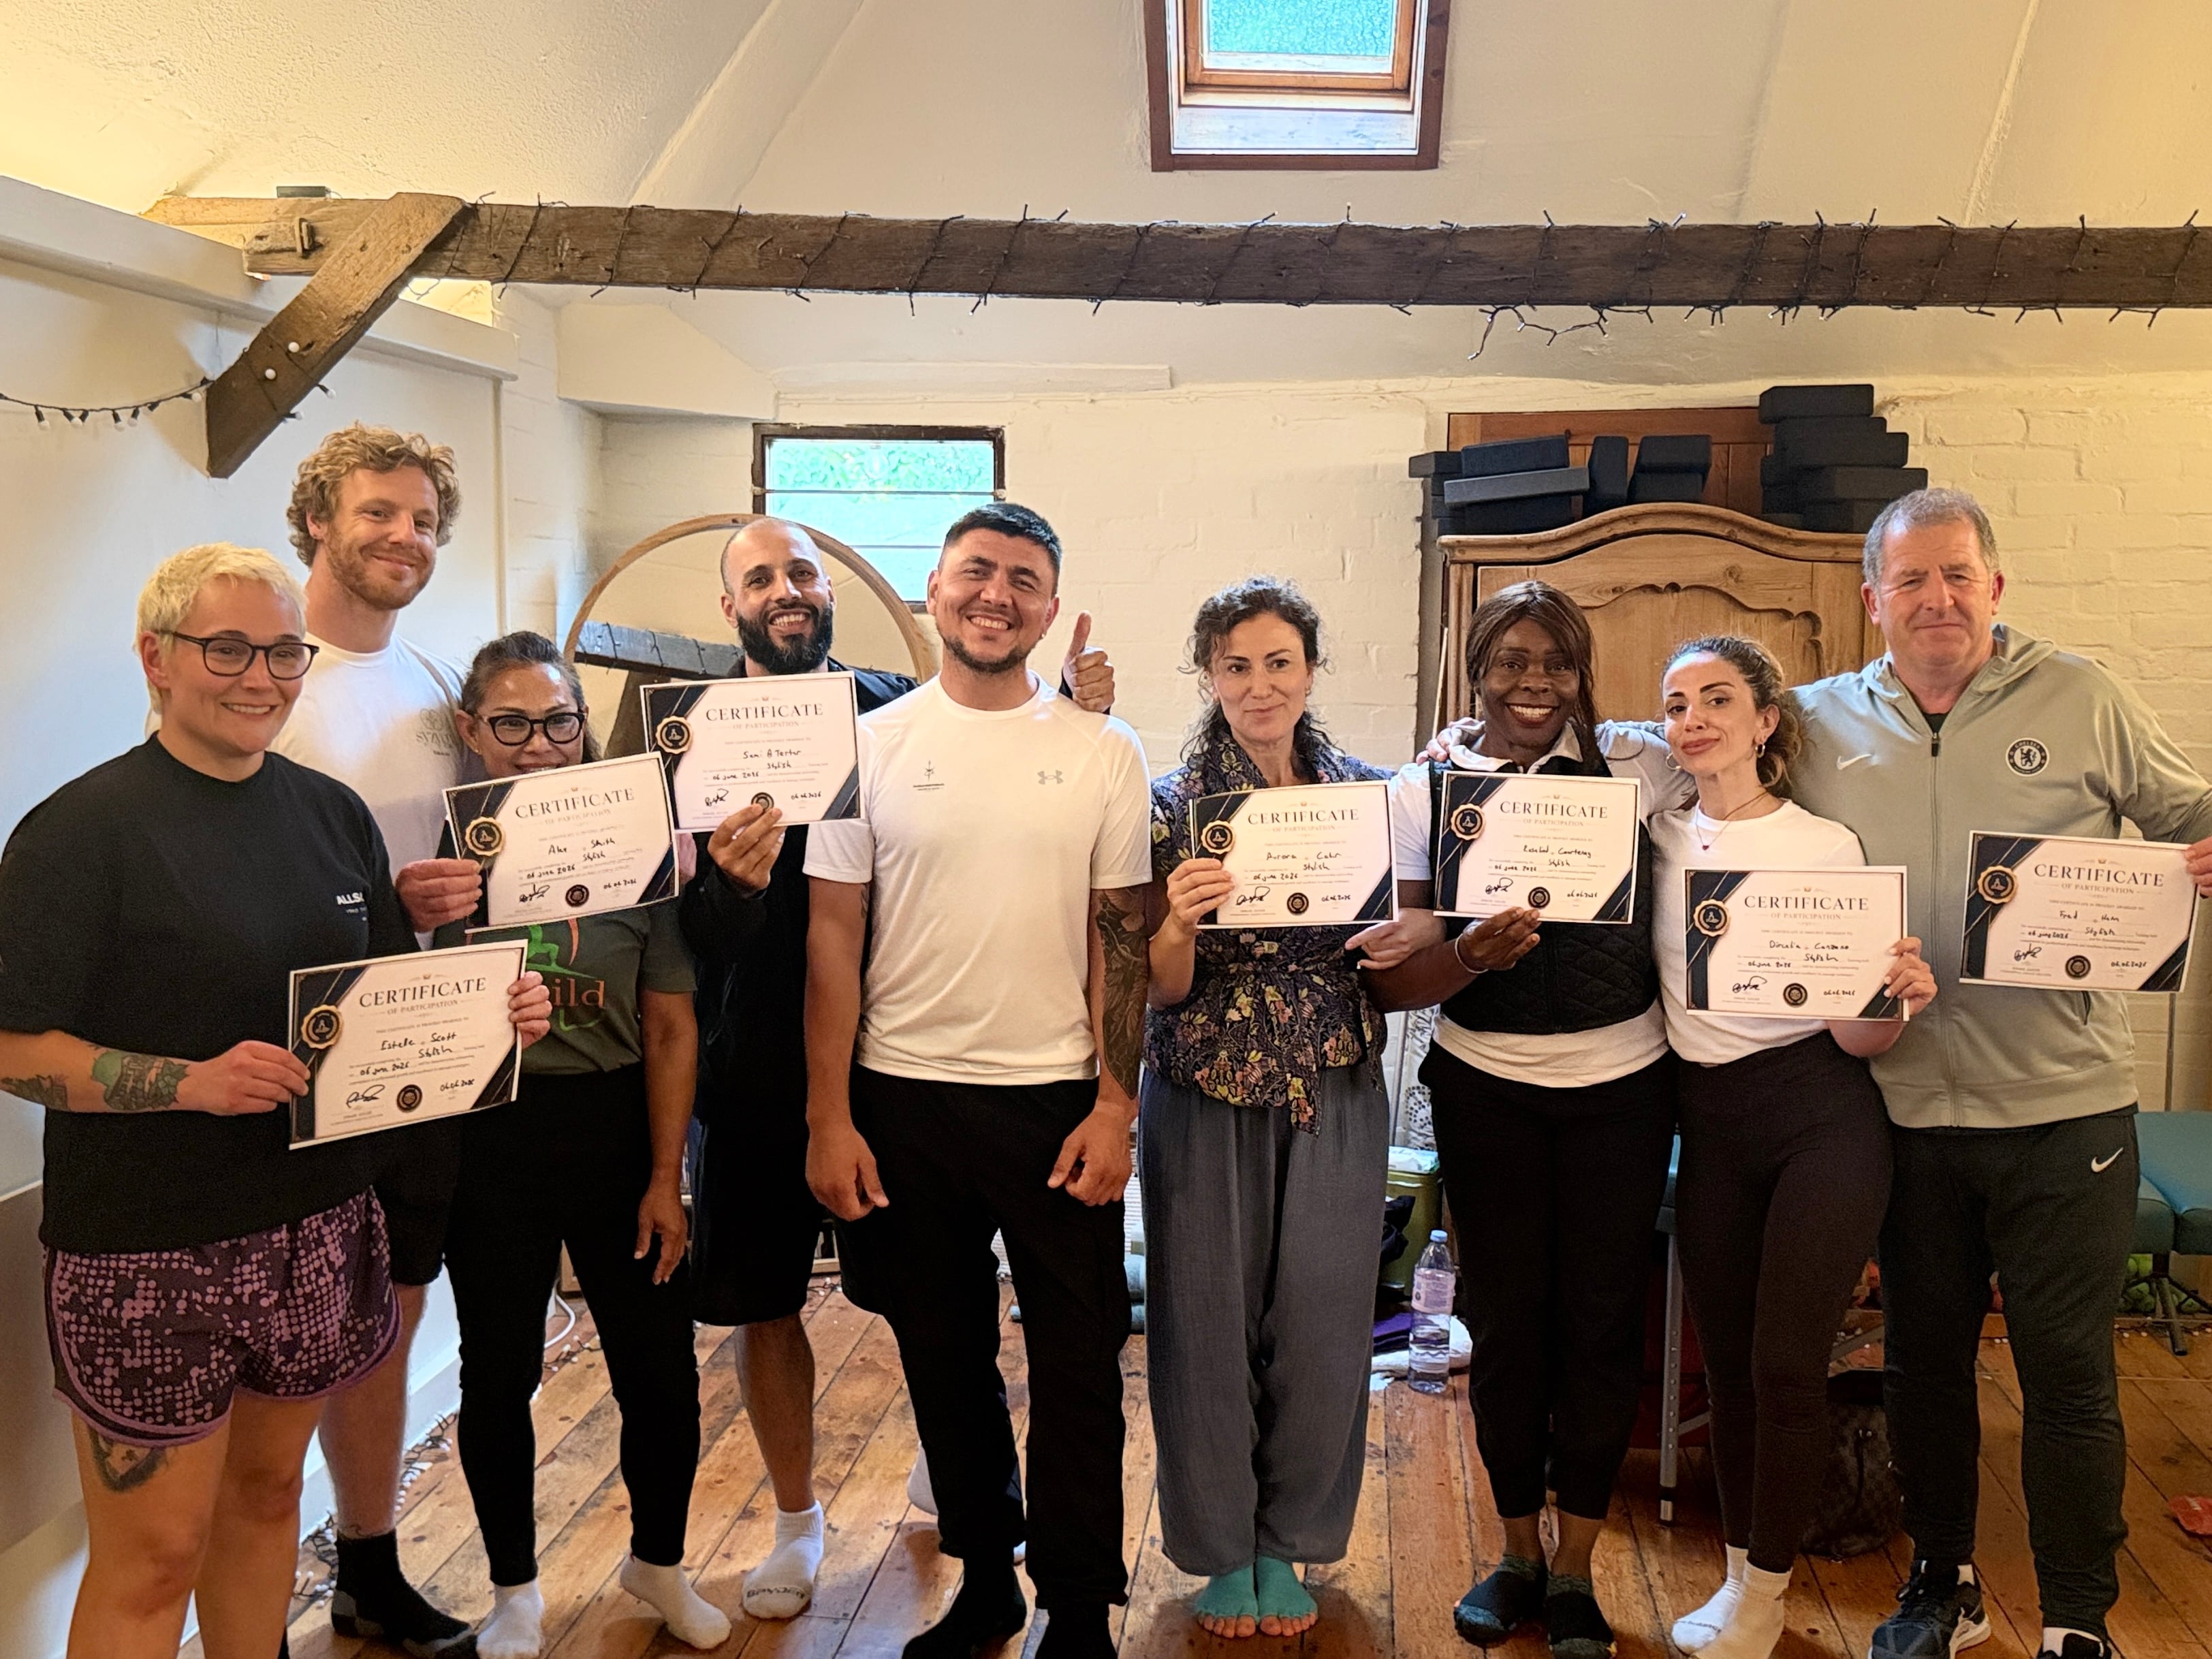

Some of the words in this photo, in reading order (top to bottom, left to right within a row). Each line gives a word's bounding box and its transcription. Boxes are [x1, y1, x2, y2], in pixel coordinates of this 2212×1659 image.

[706, 703, 823, 721] CERTIFICATE
[515, 788, 635, 819] CERTIFICATE
[1500, 801, 1608, 819] CERTIFICATE
[1248, 809, 1359, 825] CERTIFICATE
[2034, 864, 2164, 887] CERTIFICATE
[2074, 884, 2134, 894] PARTICIPATION
[1744, 896, 1869, 911] CERTIFICATE
[360, 977, 486, 1007] CERTIFICATE
[552, 978, 605, 1009] ild
[400, 999, 458, 1013] PARTICIPATION
